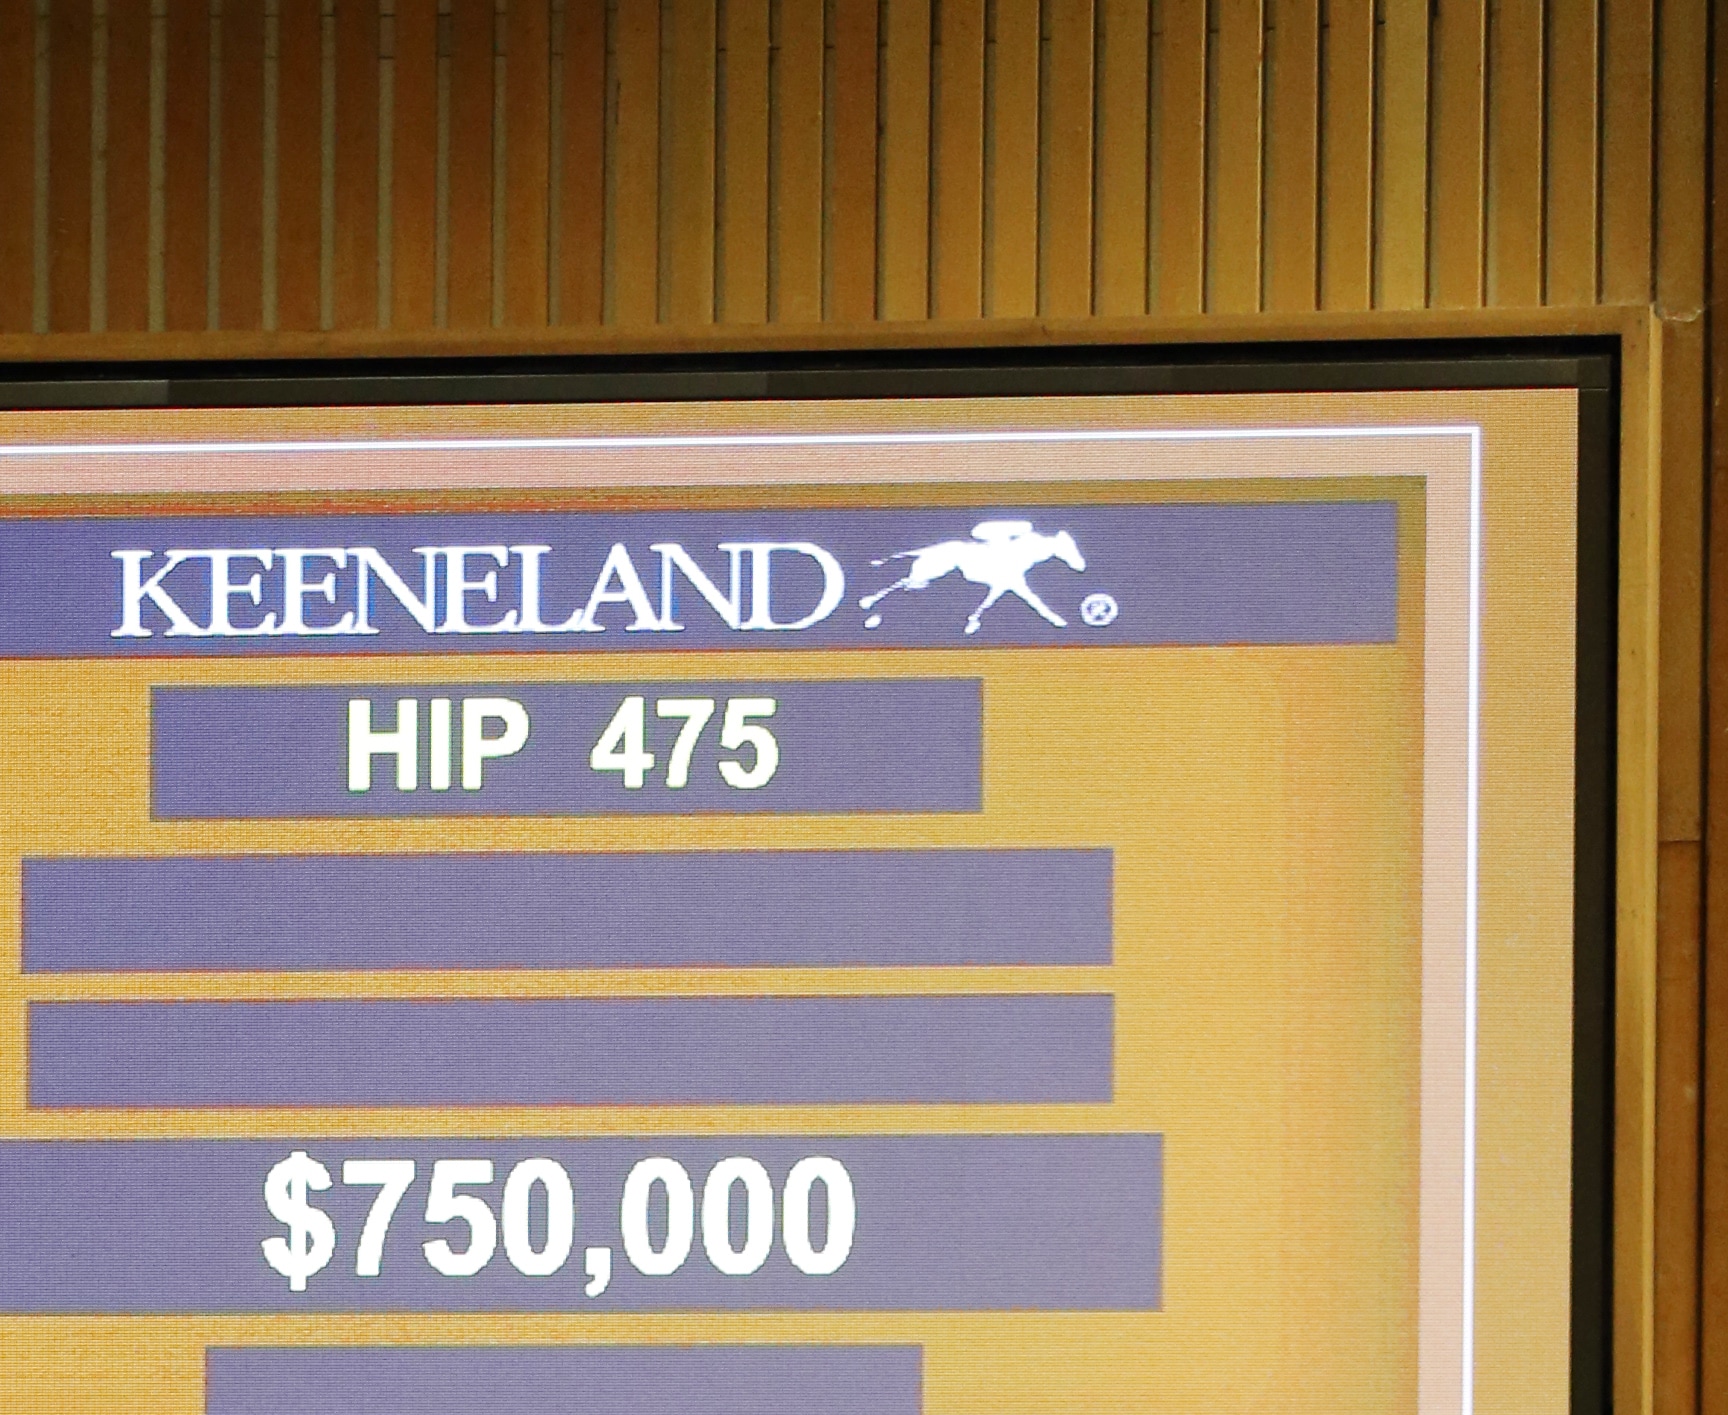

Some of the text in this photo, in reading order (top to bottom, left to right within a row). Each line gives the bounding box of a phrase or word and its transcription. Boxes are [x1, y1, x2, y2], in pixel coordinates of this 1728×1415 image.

[110, 541, 846, 638] KEENELAND
[347, 695, 780, 791] HIP 475
[260, 1151, 856, 1298] $750,000
